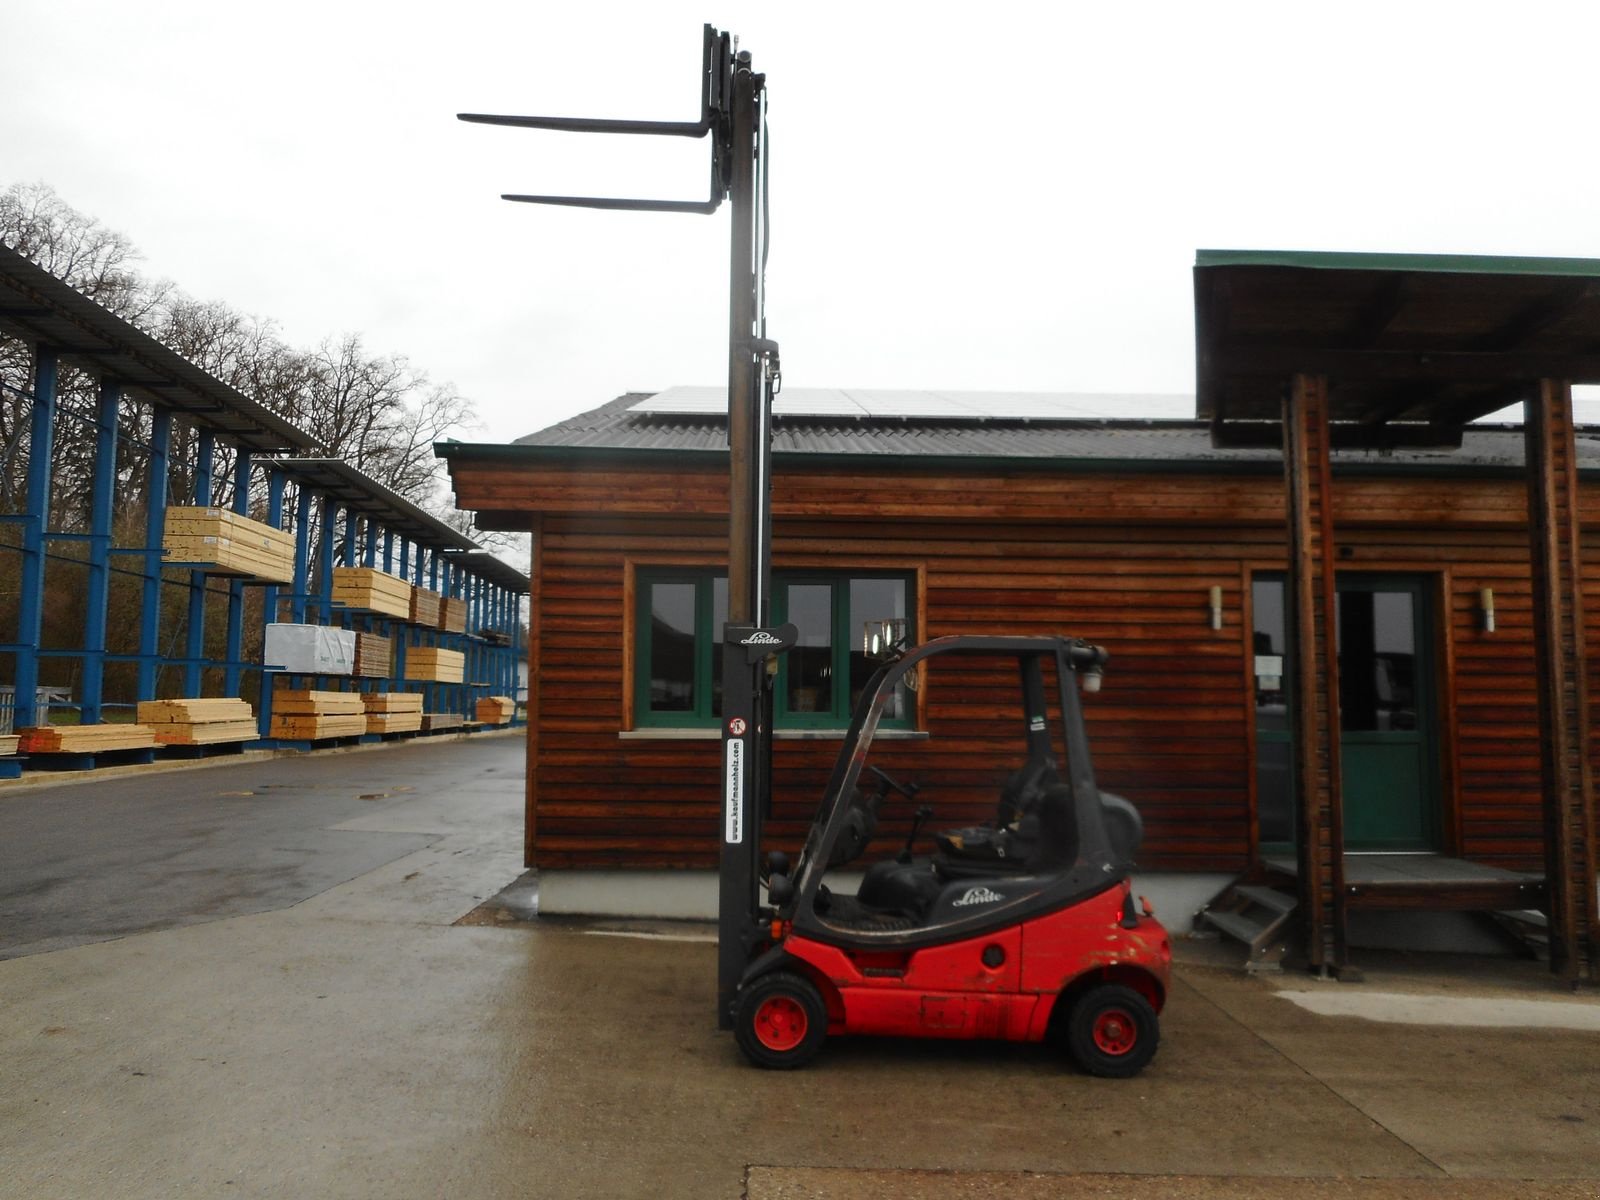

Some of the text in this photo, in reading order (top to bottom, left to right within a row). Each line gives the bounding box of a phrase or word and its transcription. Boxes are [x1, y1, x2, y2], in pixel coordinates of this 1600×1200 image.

[741, 631, 782, 644] Linde
[731, 742, 740, 840] www.kaufmannholz.com
[952, 887, 1006, 907] Linde
